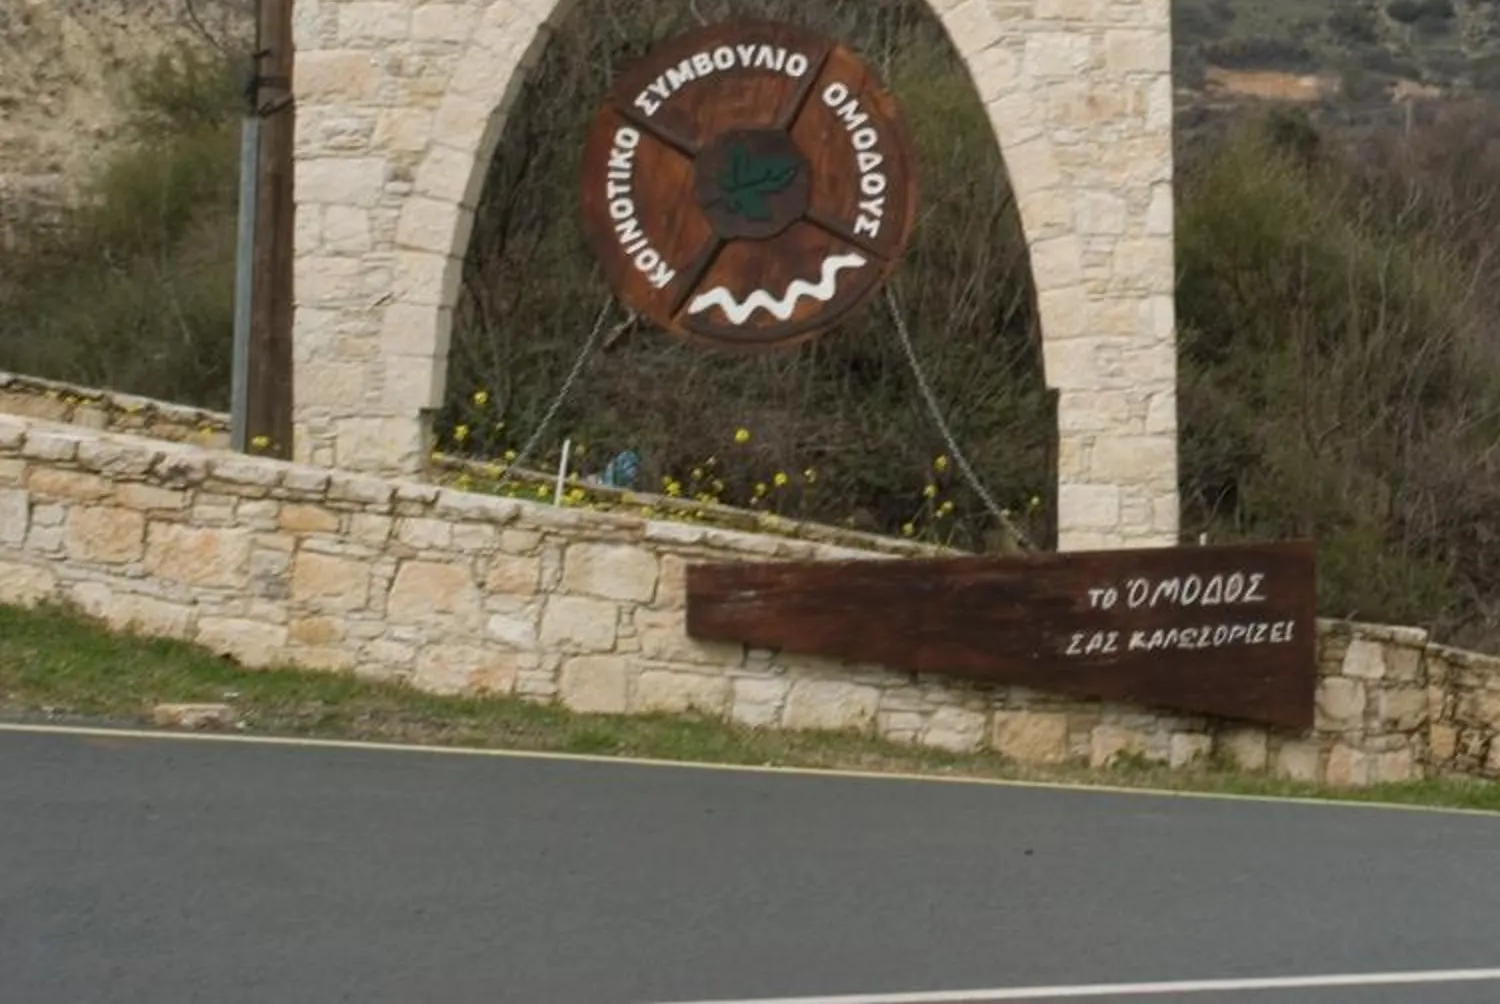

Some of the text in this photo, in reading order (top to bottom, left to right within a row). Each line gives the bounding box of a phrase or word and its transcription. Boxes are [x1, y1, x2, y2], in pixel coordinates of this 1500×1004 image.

[607, 44, 887, 289] ΚΟΙΝΟΤΙΚΟ ΣΥΜΒΟΥΛΙΟ ΟΜΟΔΟΥΣ
[1065, 630, 1120, 655] ΣΑΣ
